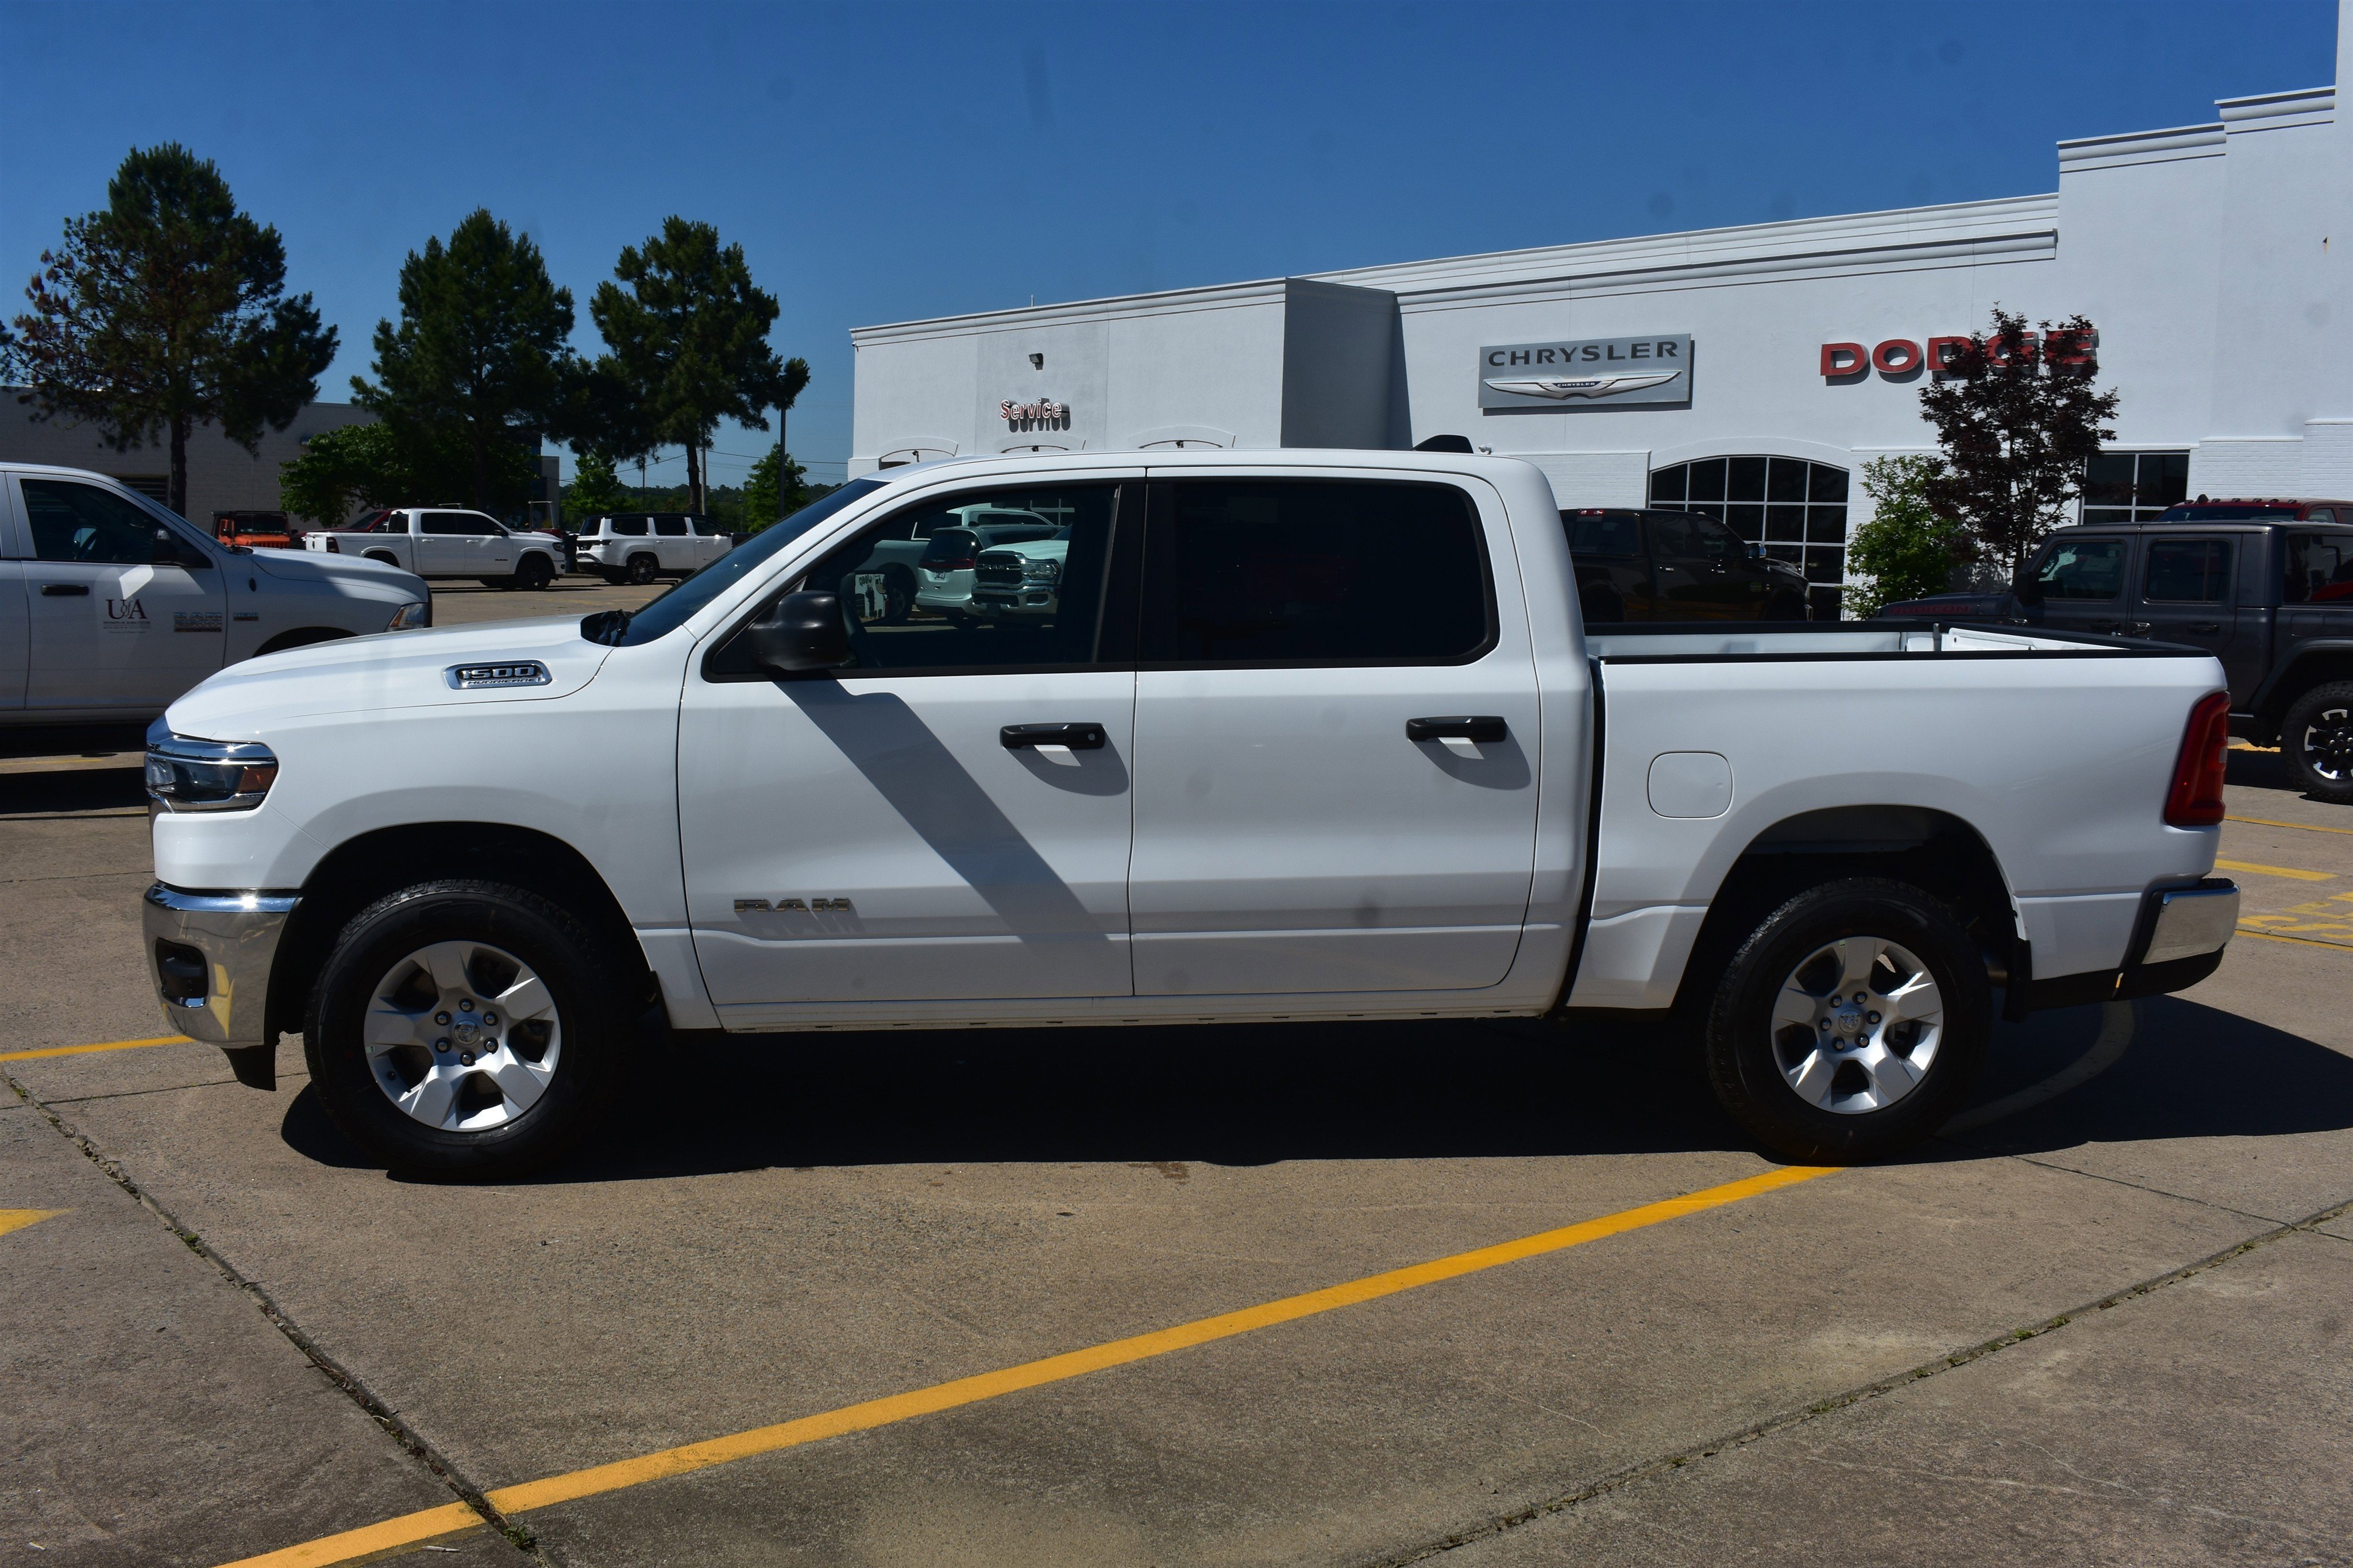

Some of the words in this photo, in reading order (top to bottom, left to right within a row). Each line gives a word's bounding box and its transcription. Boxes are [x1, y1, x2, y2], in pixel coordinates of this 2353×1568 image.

[1488, 341, 1679, 366] CHRYSLER
[1000, 397, 1062, 420] Service
[1889, 604, 1970, 615] RUBICON
[461, 666, 535, 679] 1500
[734, 898, 850, 912] RAM
